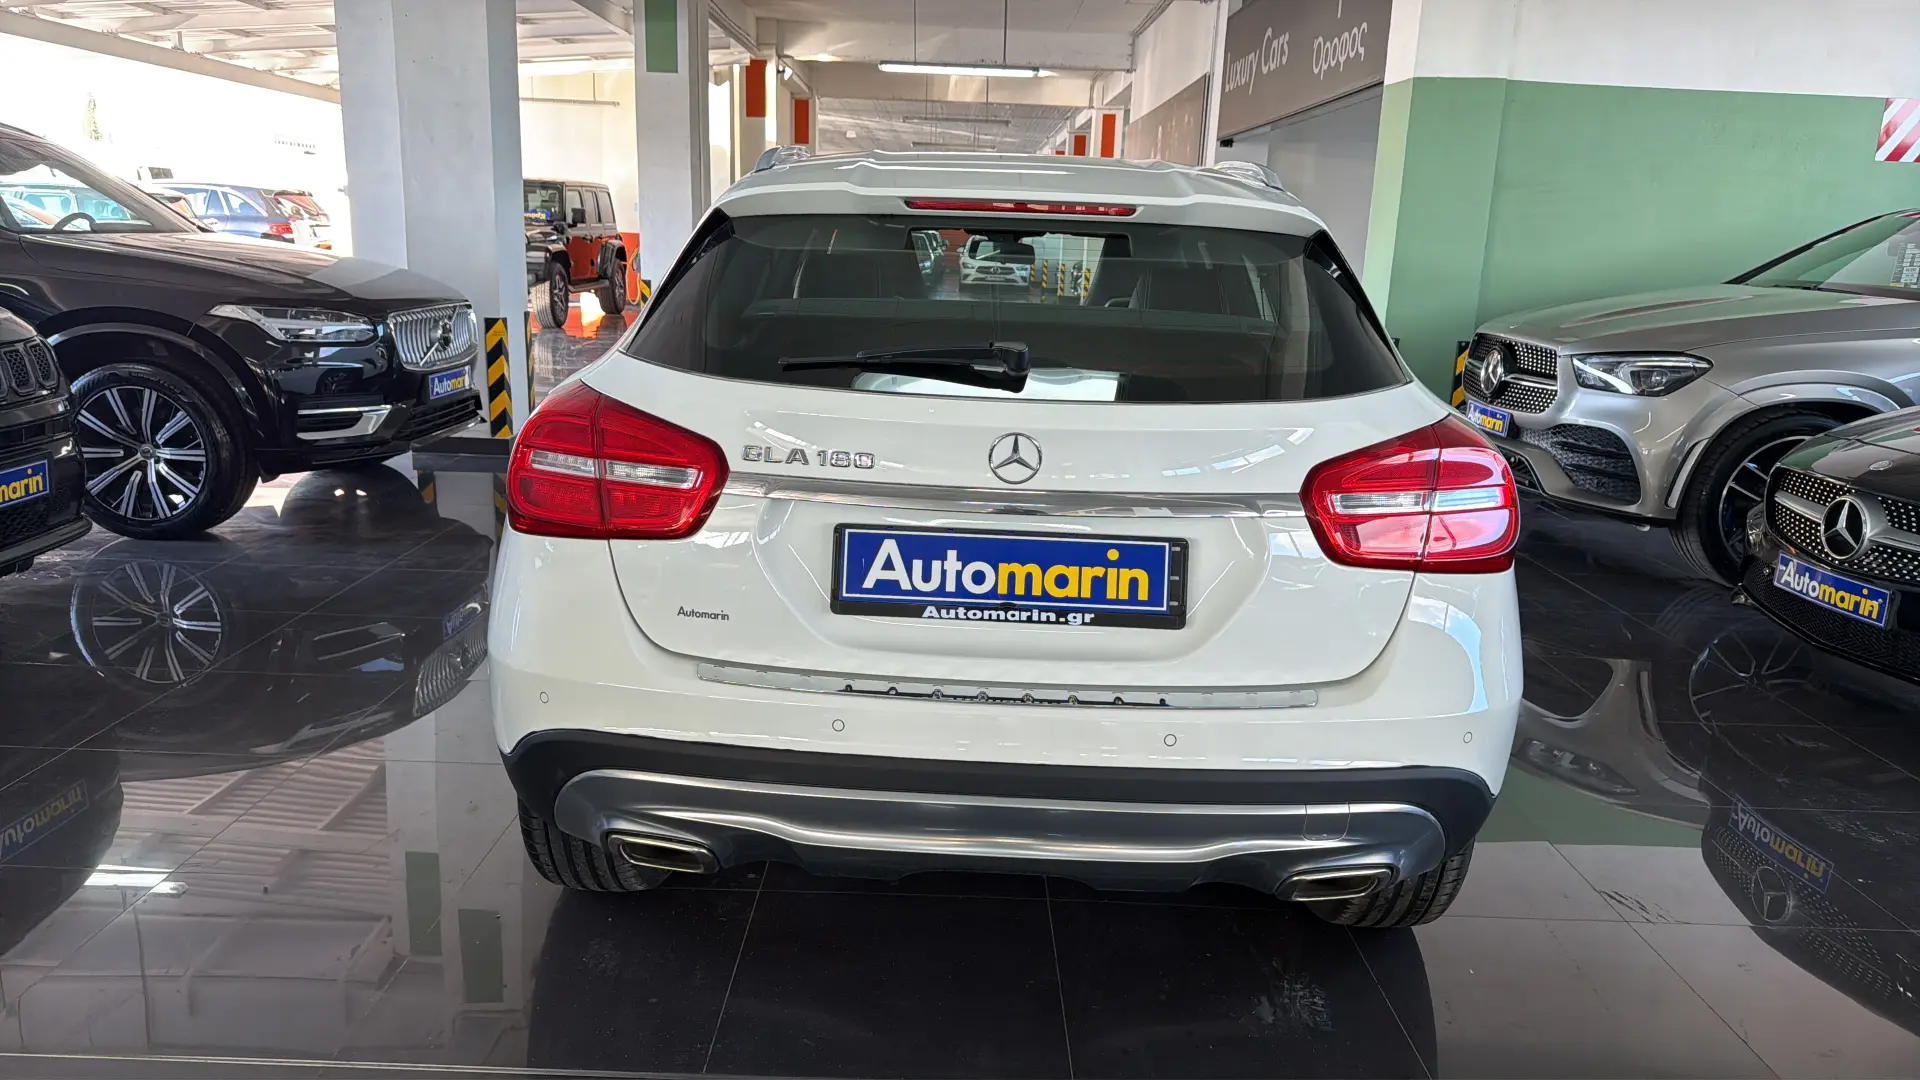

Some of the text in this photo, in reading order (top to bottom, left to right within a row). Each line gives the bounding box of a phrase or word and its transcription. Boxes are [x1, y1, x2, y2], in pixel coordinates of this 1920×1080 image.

[1225, 27, 1289, 95] Luxury Cars
[742, 445, 876, 469] GLA 180
[862, 538, 1149, 601] Automarin
[1780, 560, 1879, 620] Automarin
[677, 606, 730, 621] Automarin
[921, 605, 1095, 626] Automarin.gr
